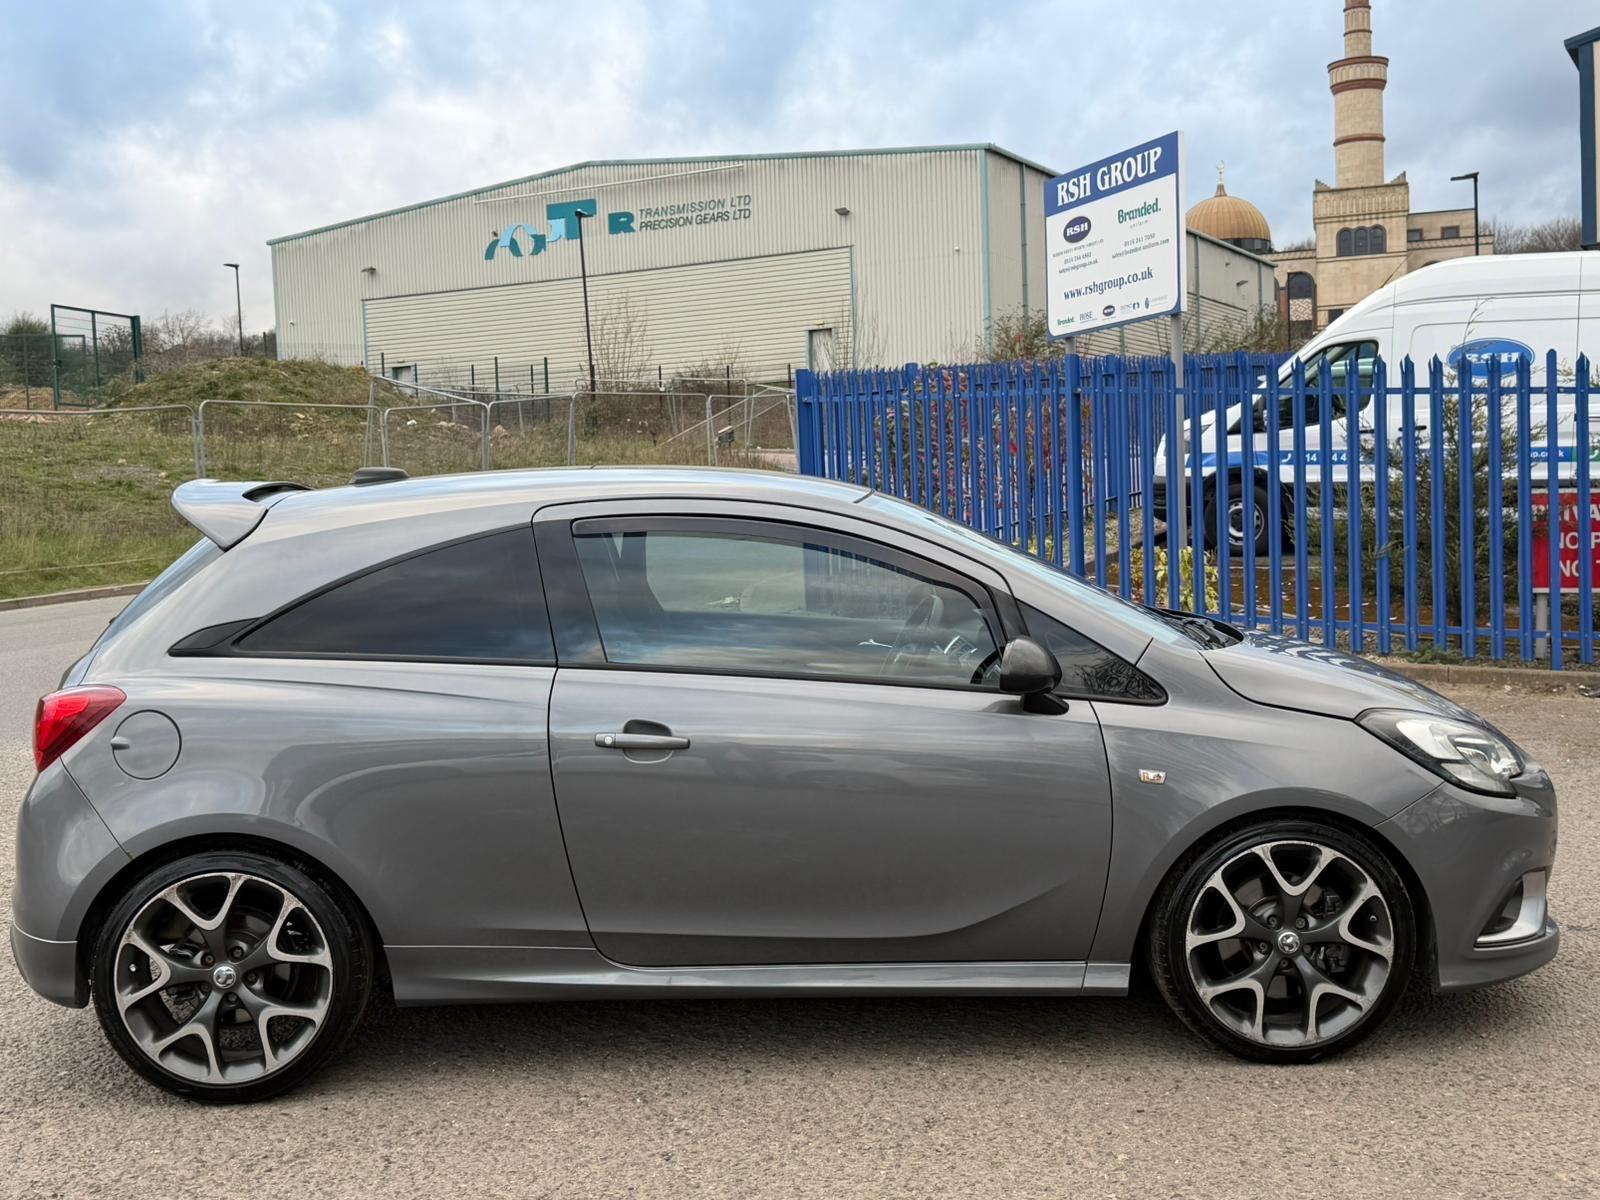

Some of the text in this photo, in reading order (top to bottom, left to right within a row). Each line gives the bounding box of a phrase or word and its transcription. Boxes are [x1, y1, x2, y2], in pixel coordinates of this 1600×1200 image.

[1056, 146, 1162, 207] RSH GROUP
[638, 194, 751, 219] TRANSMISSION LTD
[1117, 197, 1162, 224] Branded.
[638, 208, 751, 231] PRECISION GEARS LTD
[1066, 221, 1089, 237] RSH
[1063, 266, 1154, 301] www.rshgroup.co.uk
[1464, 351, 1520, 364] RSH
